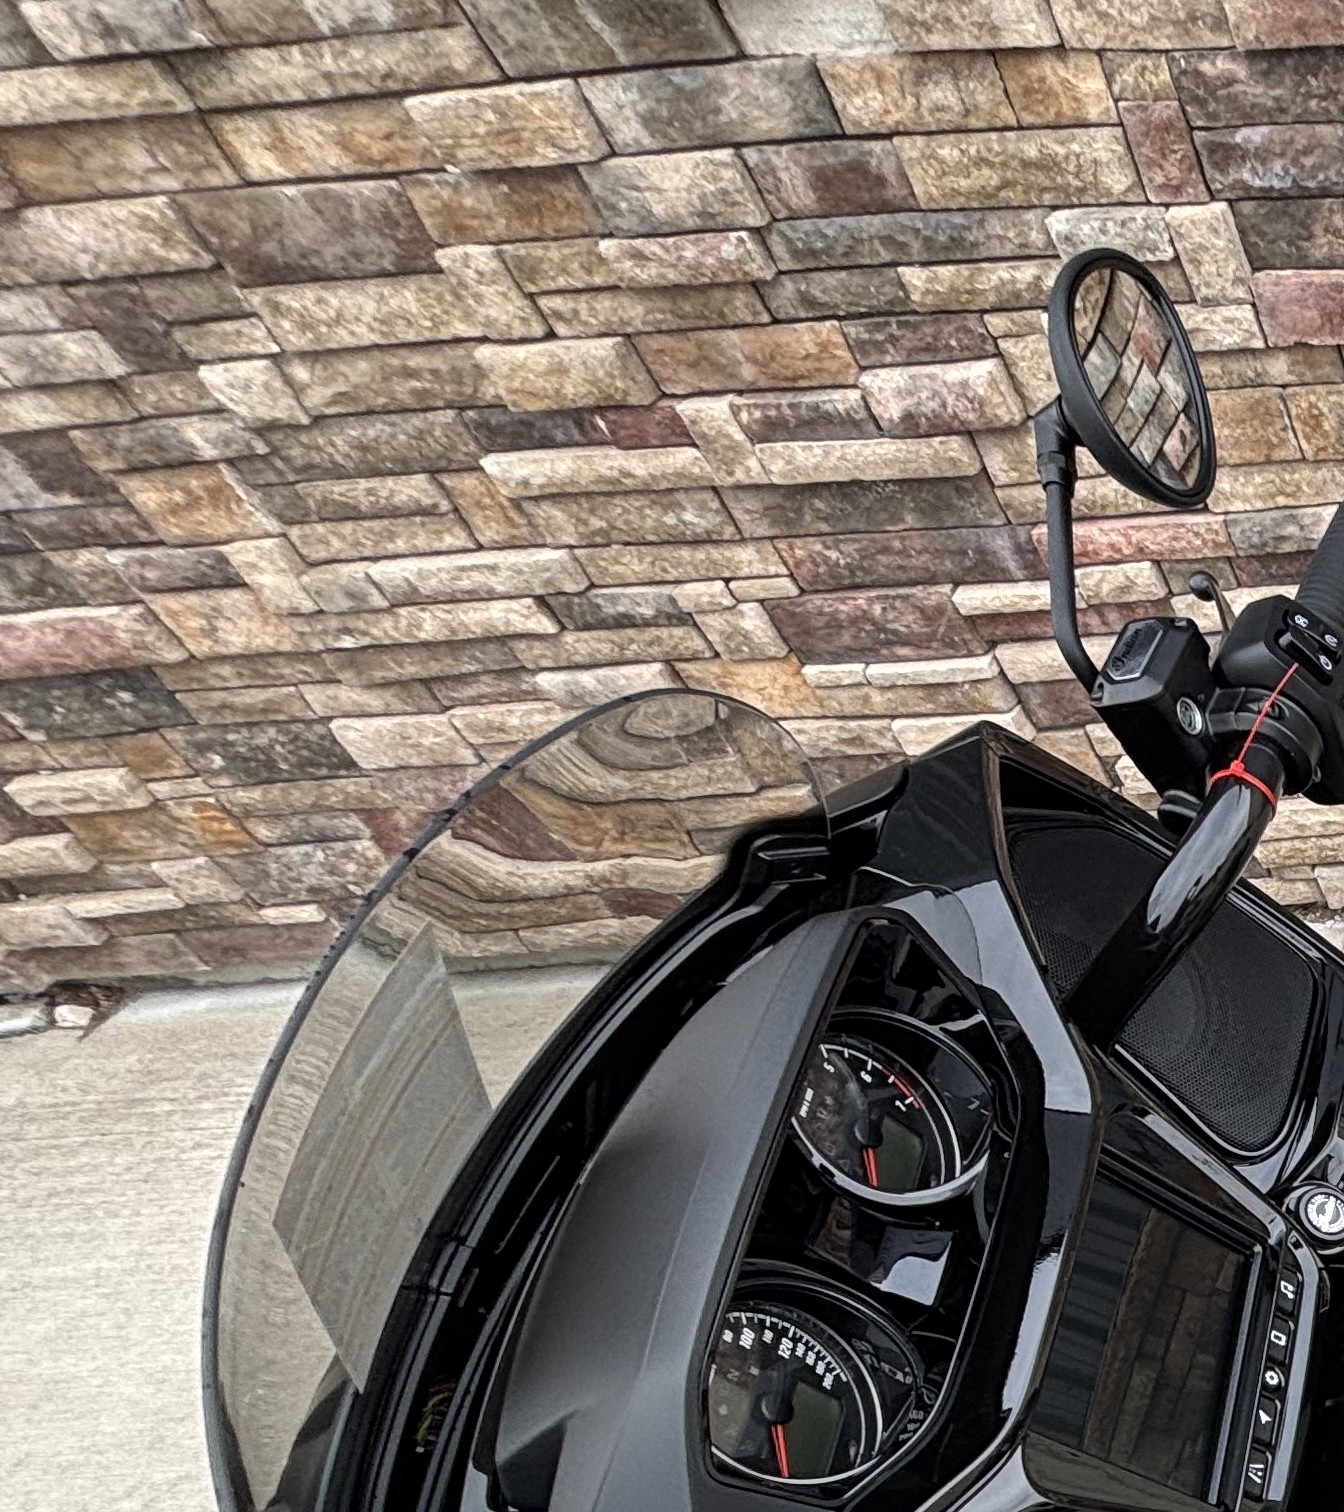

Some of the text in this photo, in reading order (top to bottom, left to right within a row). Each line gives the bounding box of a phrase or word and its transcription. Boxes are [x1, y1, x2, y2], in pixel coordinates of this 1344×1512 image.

[823, 1061, 835, 1074] 5
[860, 1070, 872, 1084] 6
[738, 1327, 756, 1350] 100
[777, 1337, 794, 1360] 120
